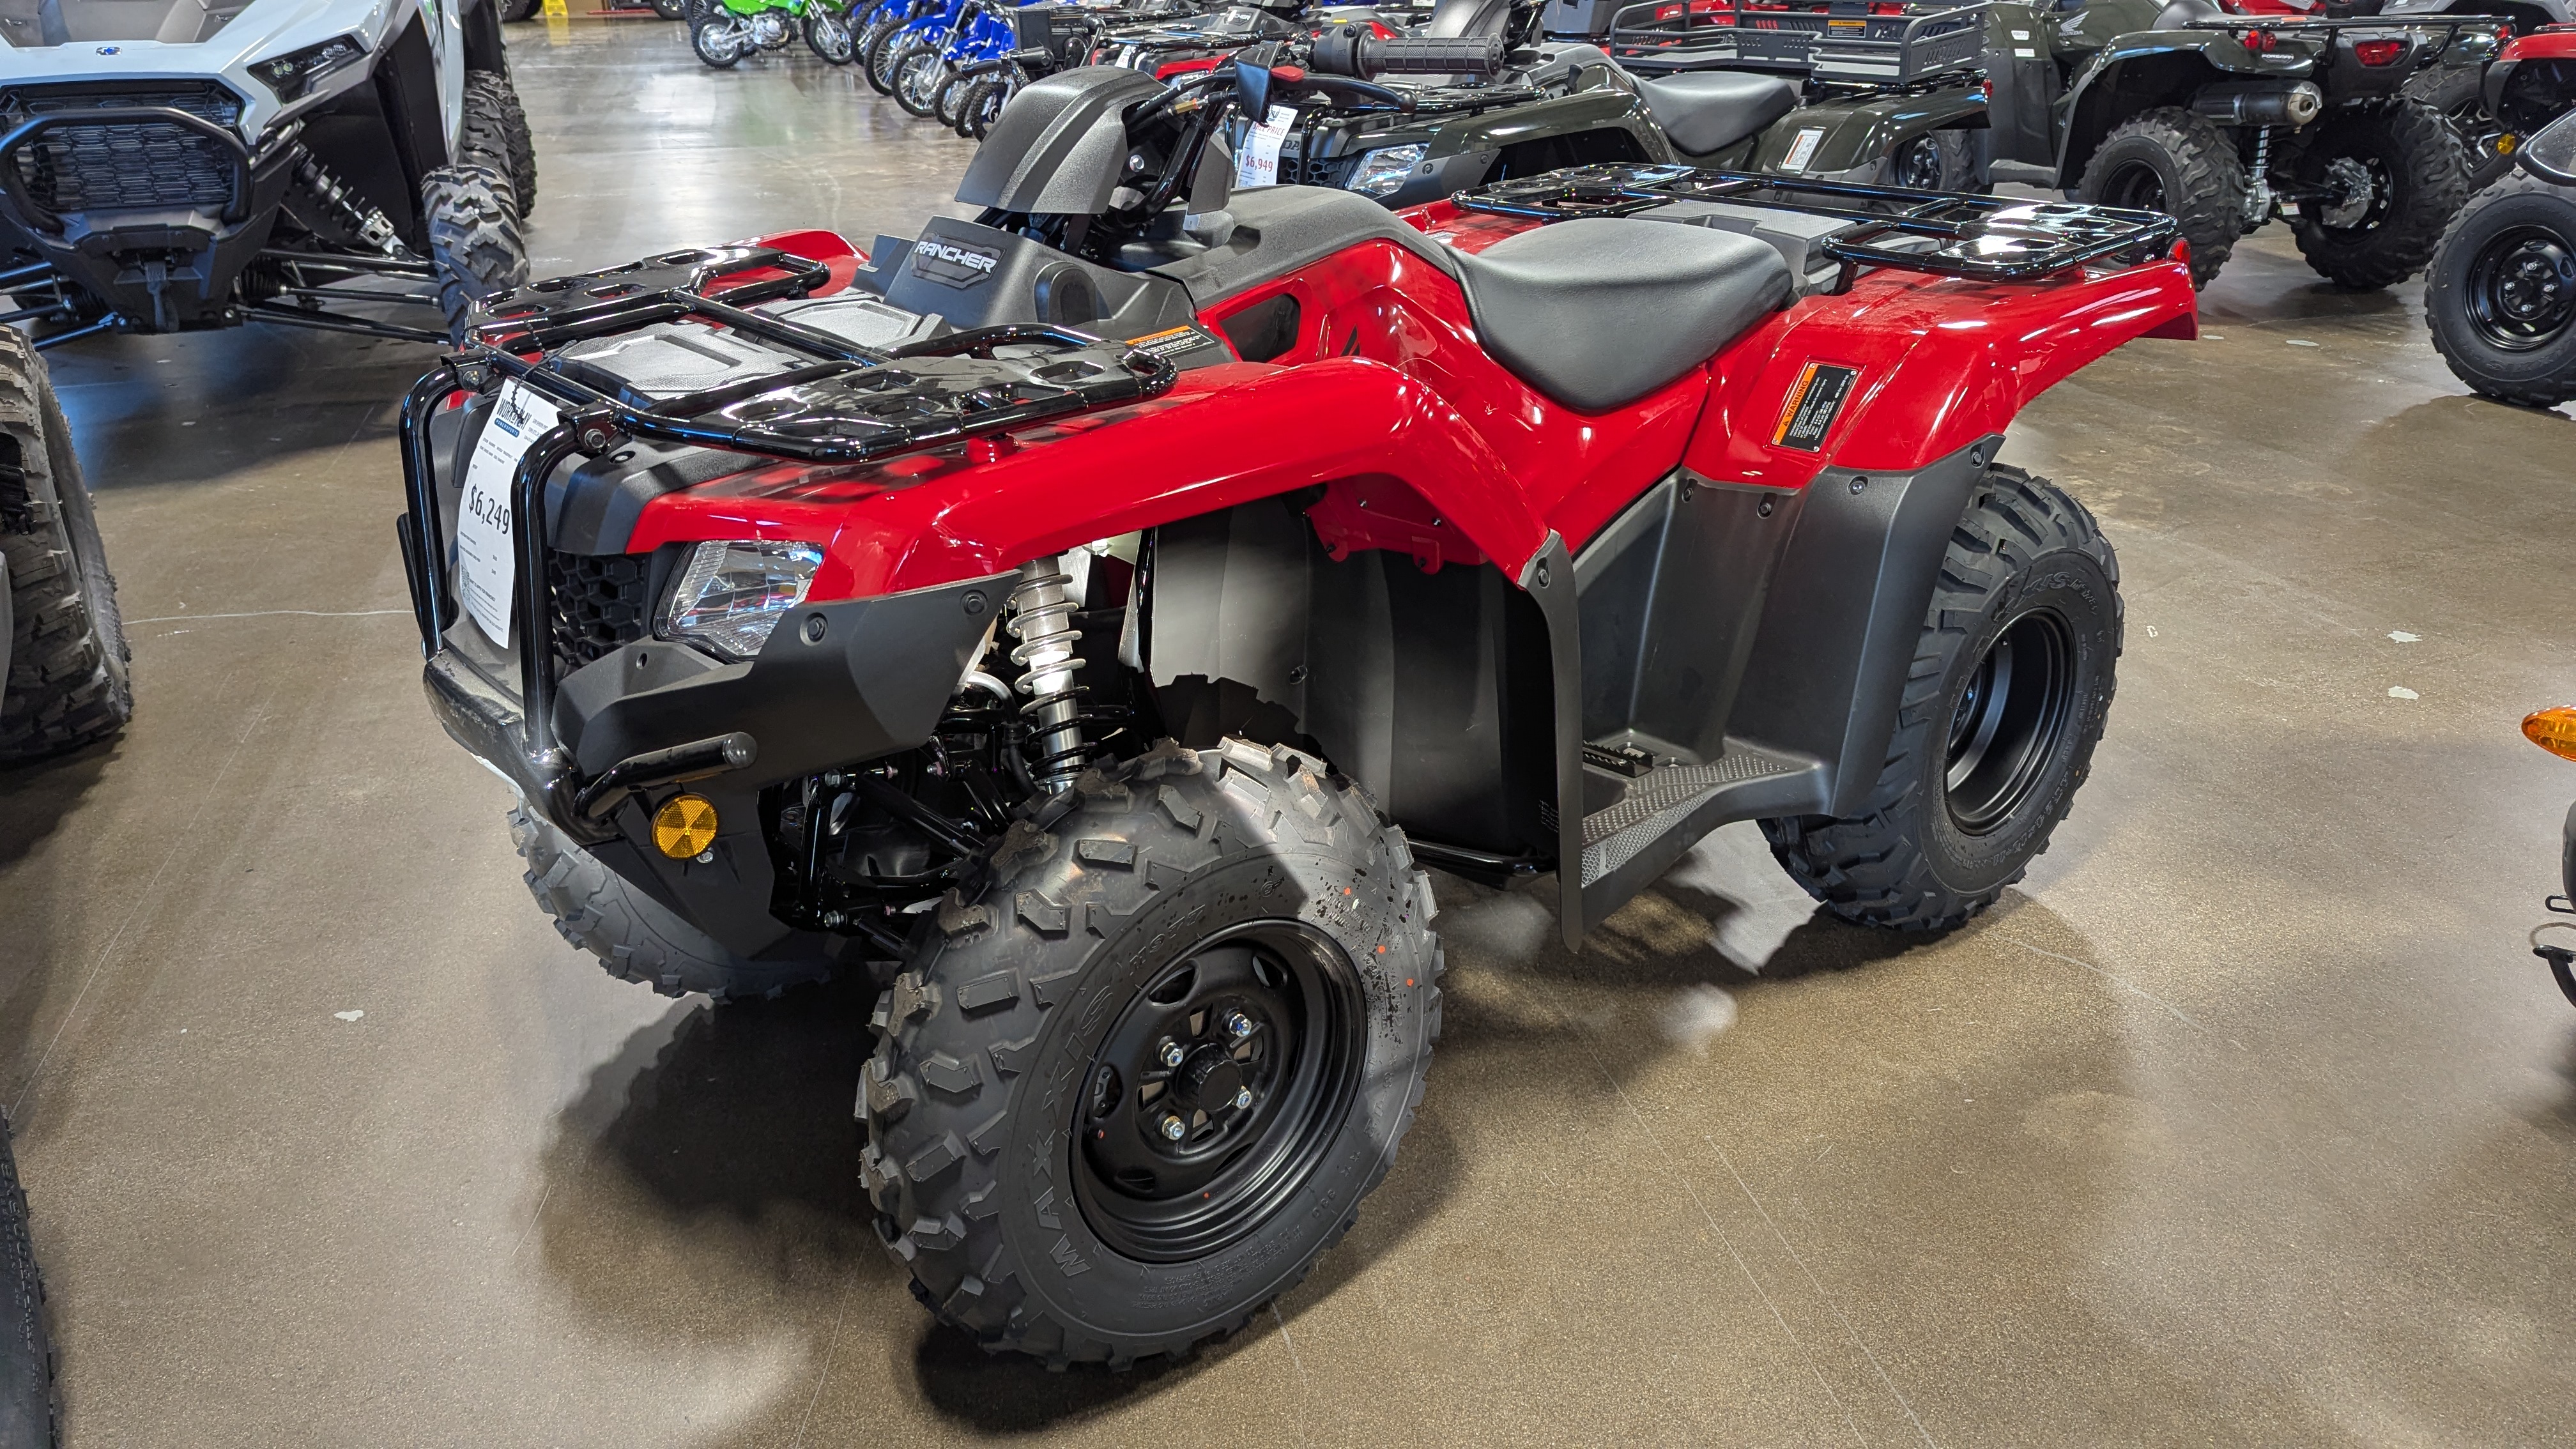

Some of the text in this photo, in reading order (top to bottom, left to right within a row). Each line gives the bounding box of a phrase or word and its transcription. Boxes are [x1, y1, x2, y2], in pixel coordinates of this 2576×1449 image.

[1268, 126, 1285, 136] PRICE
[1245, 154, 1273, 172] $6,949
[914, 241, 997, 273] RANCHER
[1788, 380, 1809, 417] WARNING
[495, 419, 518, 436] POWERSPORTS
[469, 484, 510, 534] $6,249
[1027, 984, 1113, 1278] MAXXIS
